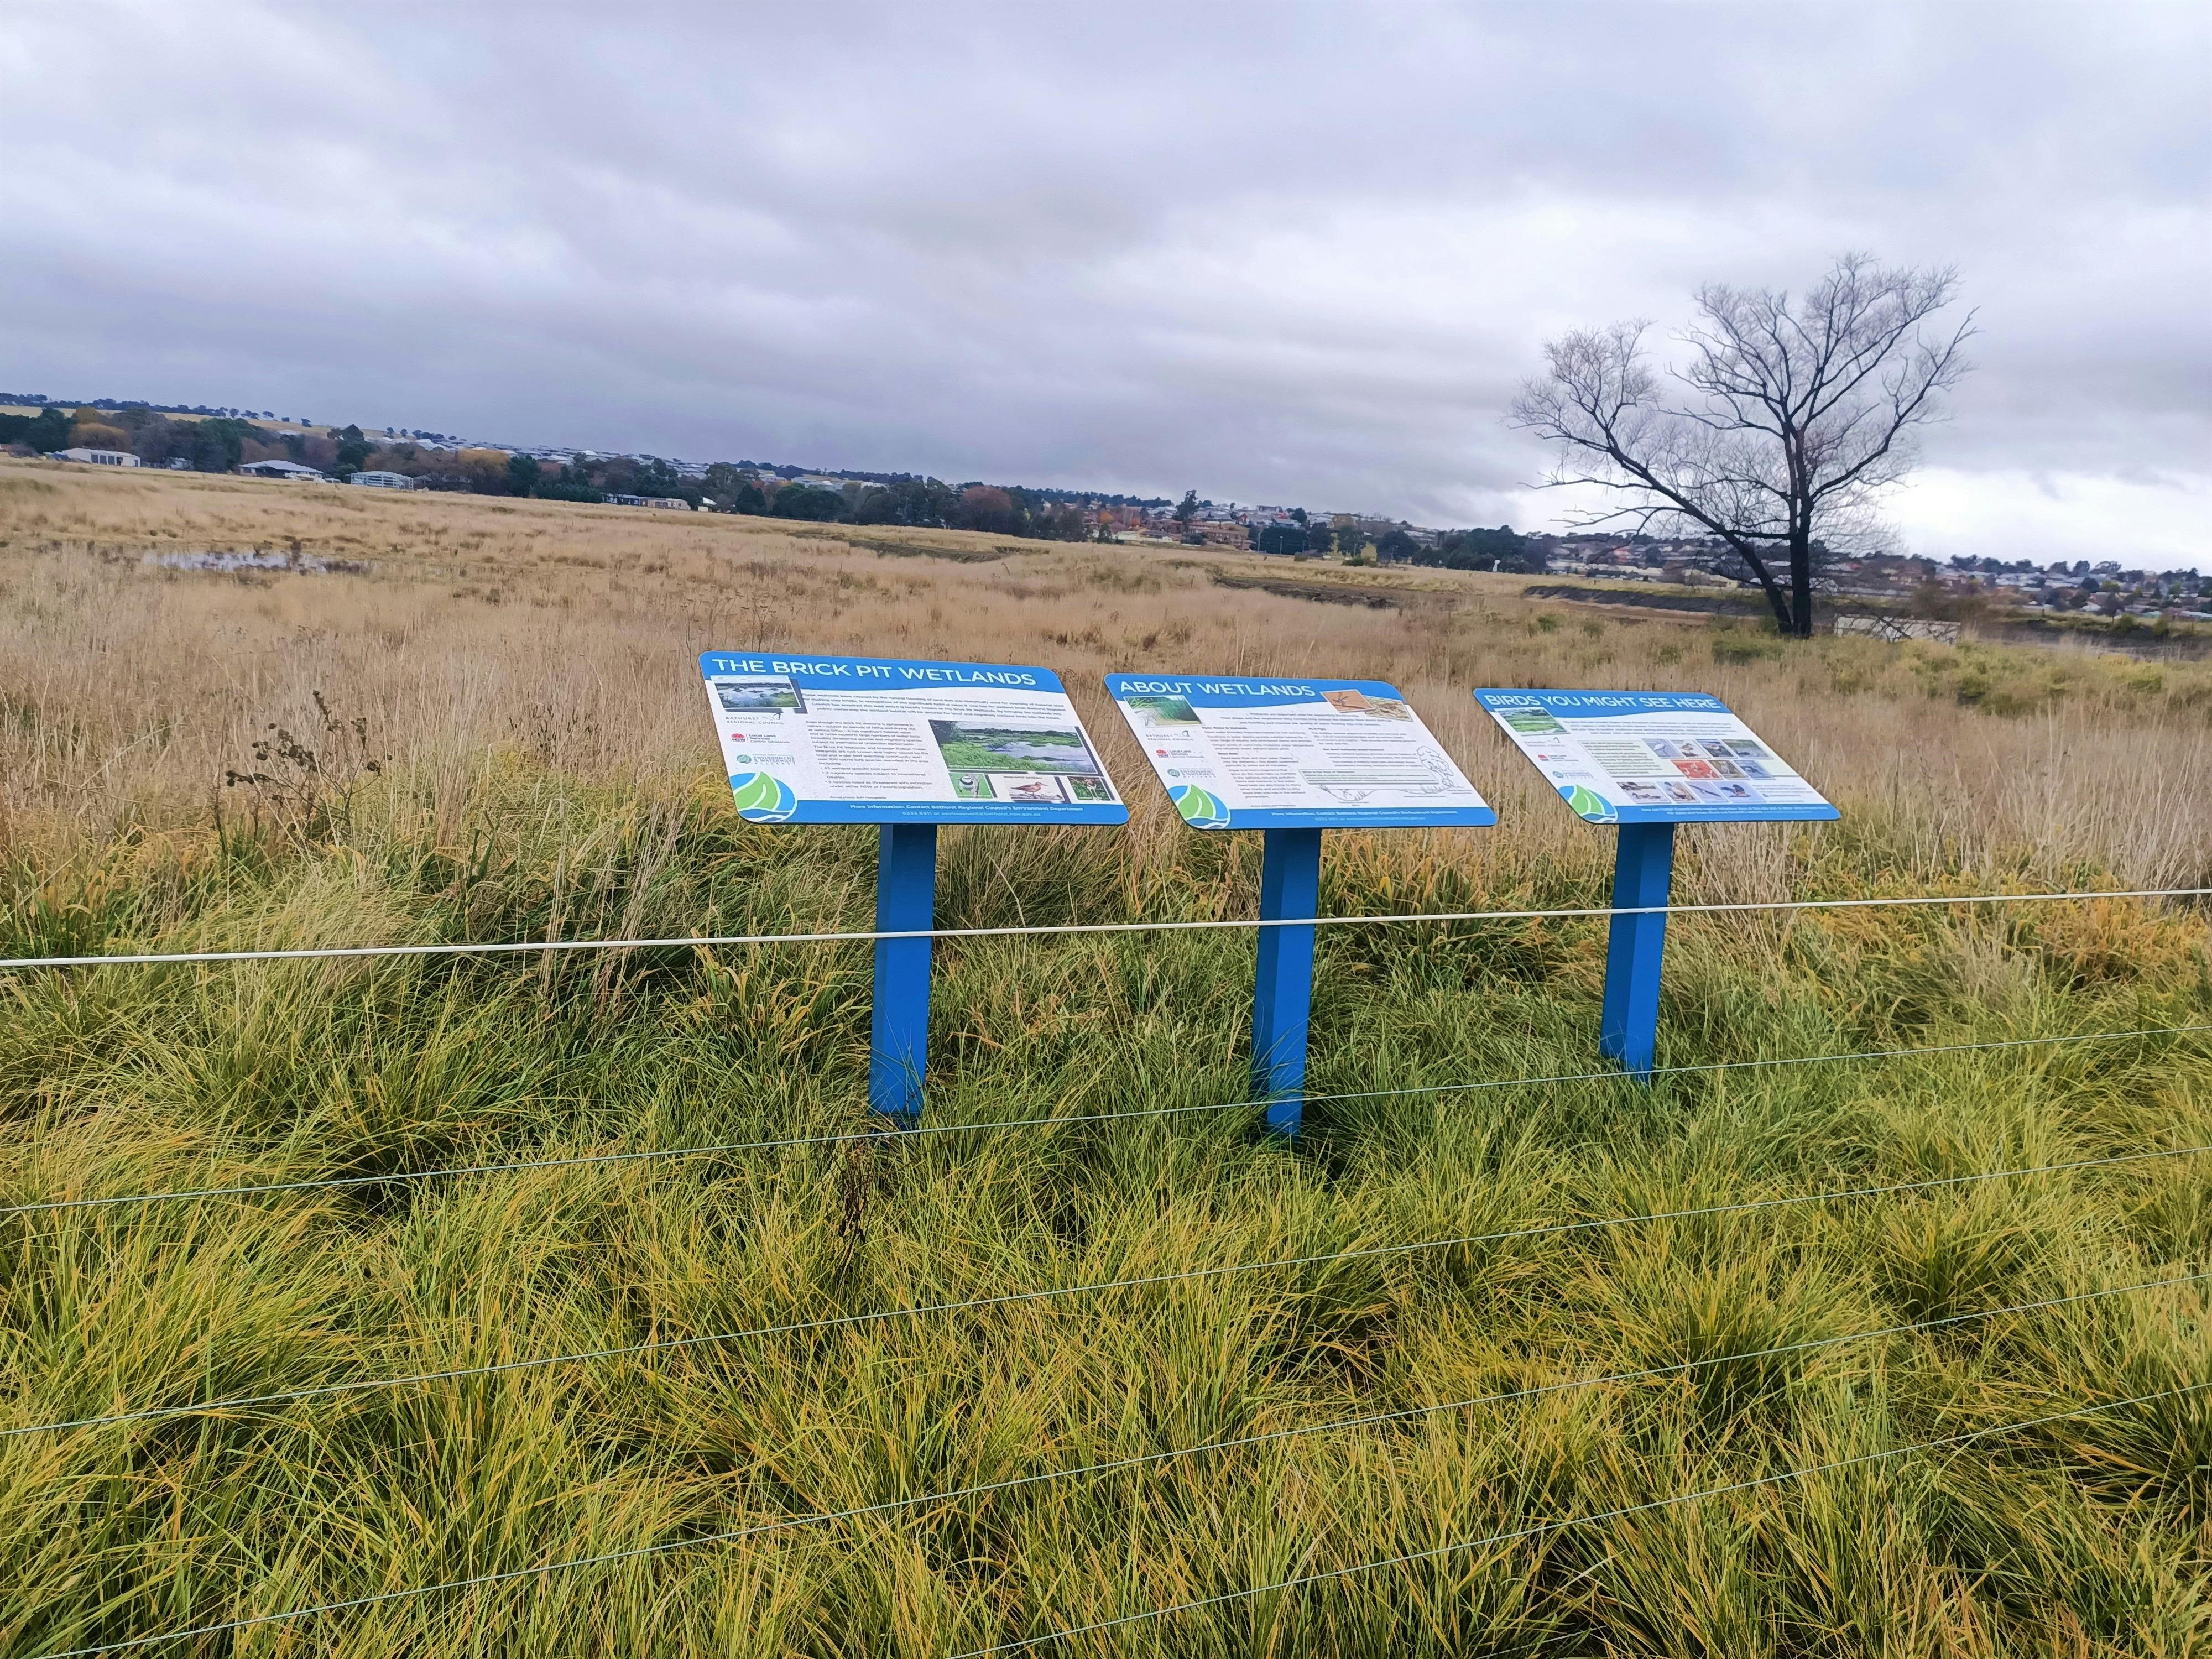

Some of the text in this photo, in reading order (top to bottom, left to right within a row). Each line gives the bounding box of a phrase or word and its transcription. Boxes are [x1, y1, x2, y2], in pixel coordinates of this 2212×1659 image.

[711, 659, 1036, 686] THE BRICK PIT WETLANDS
[1120, 681, 1316, 697] ABOUT WETLANDS
[1484, 695, 1721, 709] BIRDS YOU MIGHT SEE HERE
